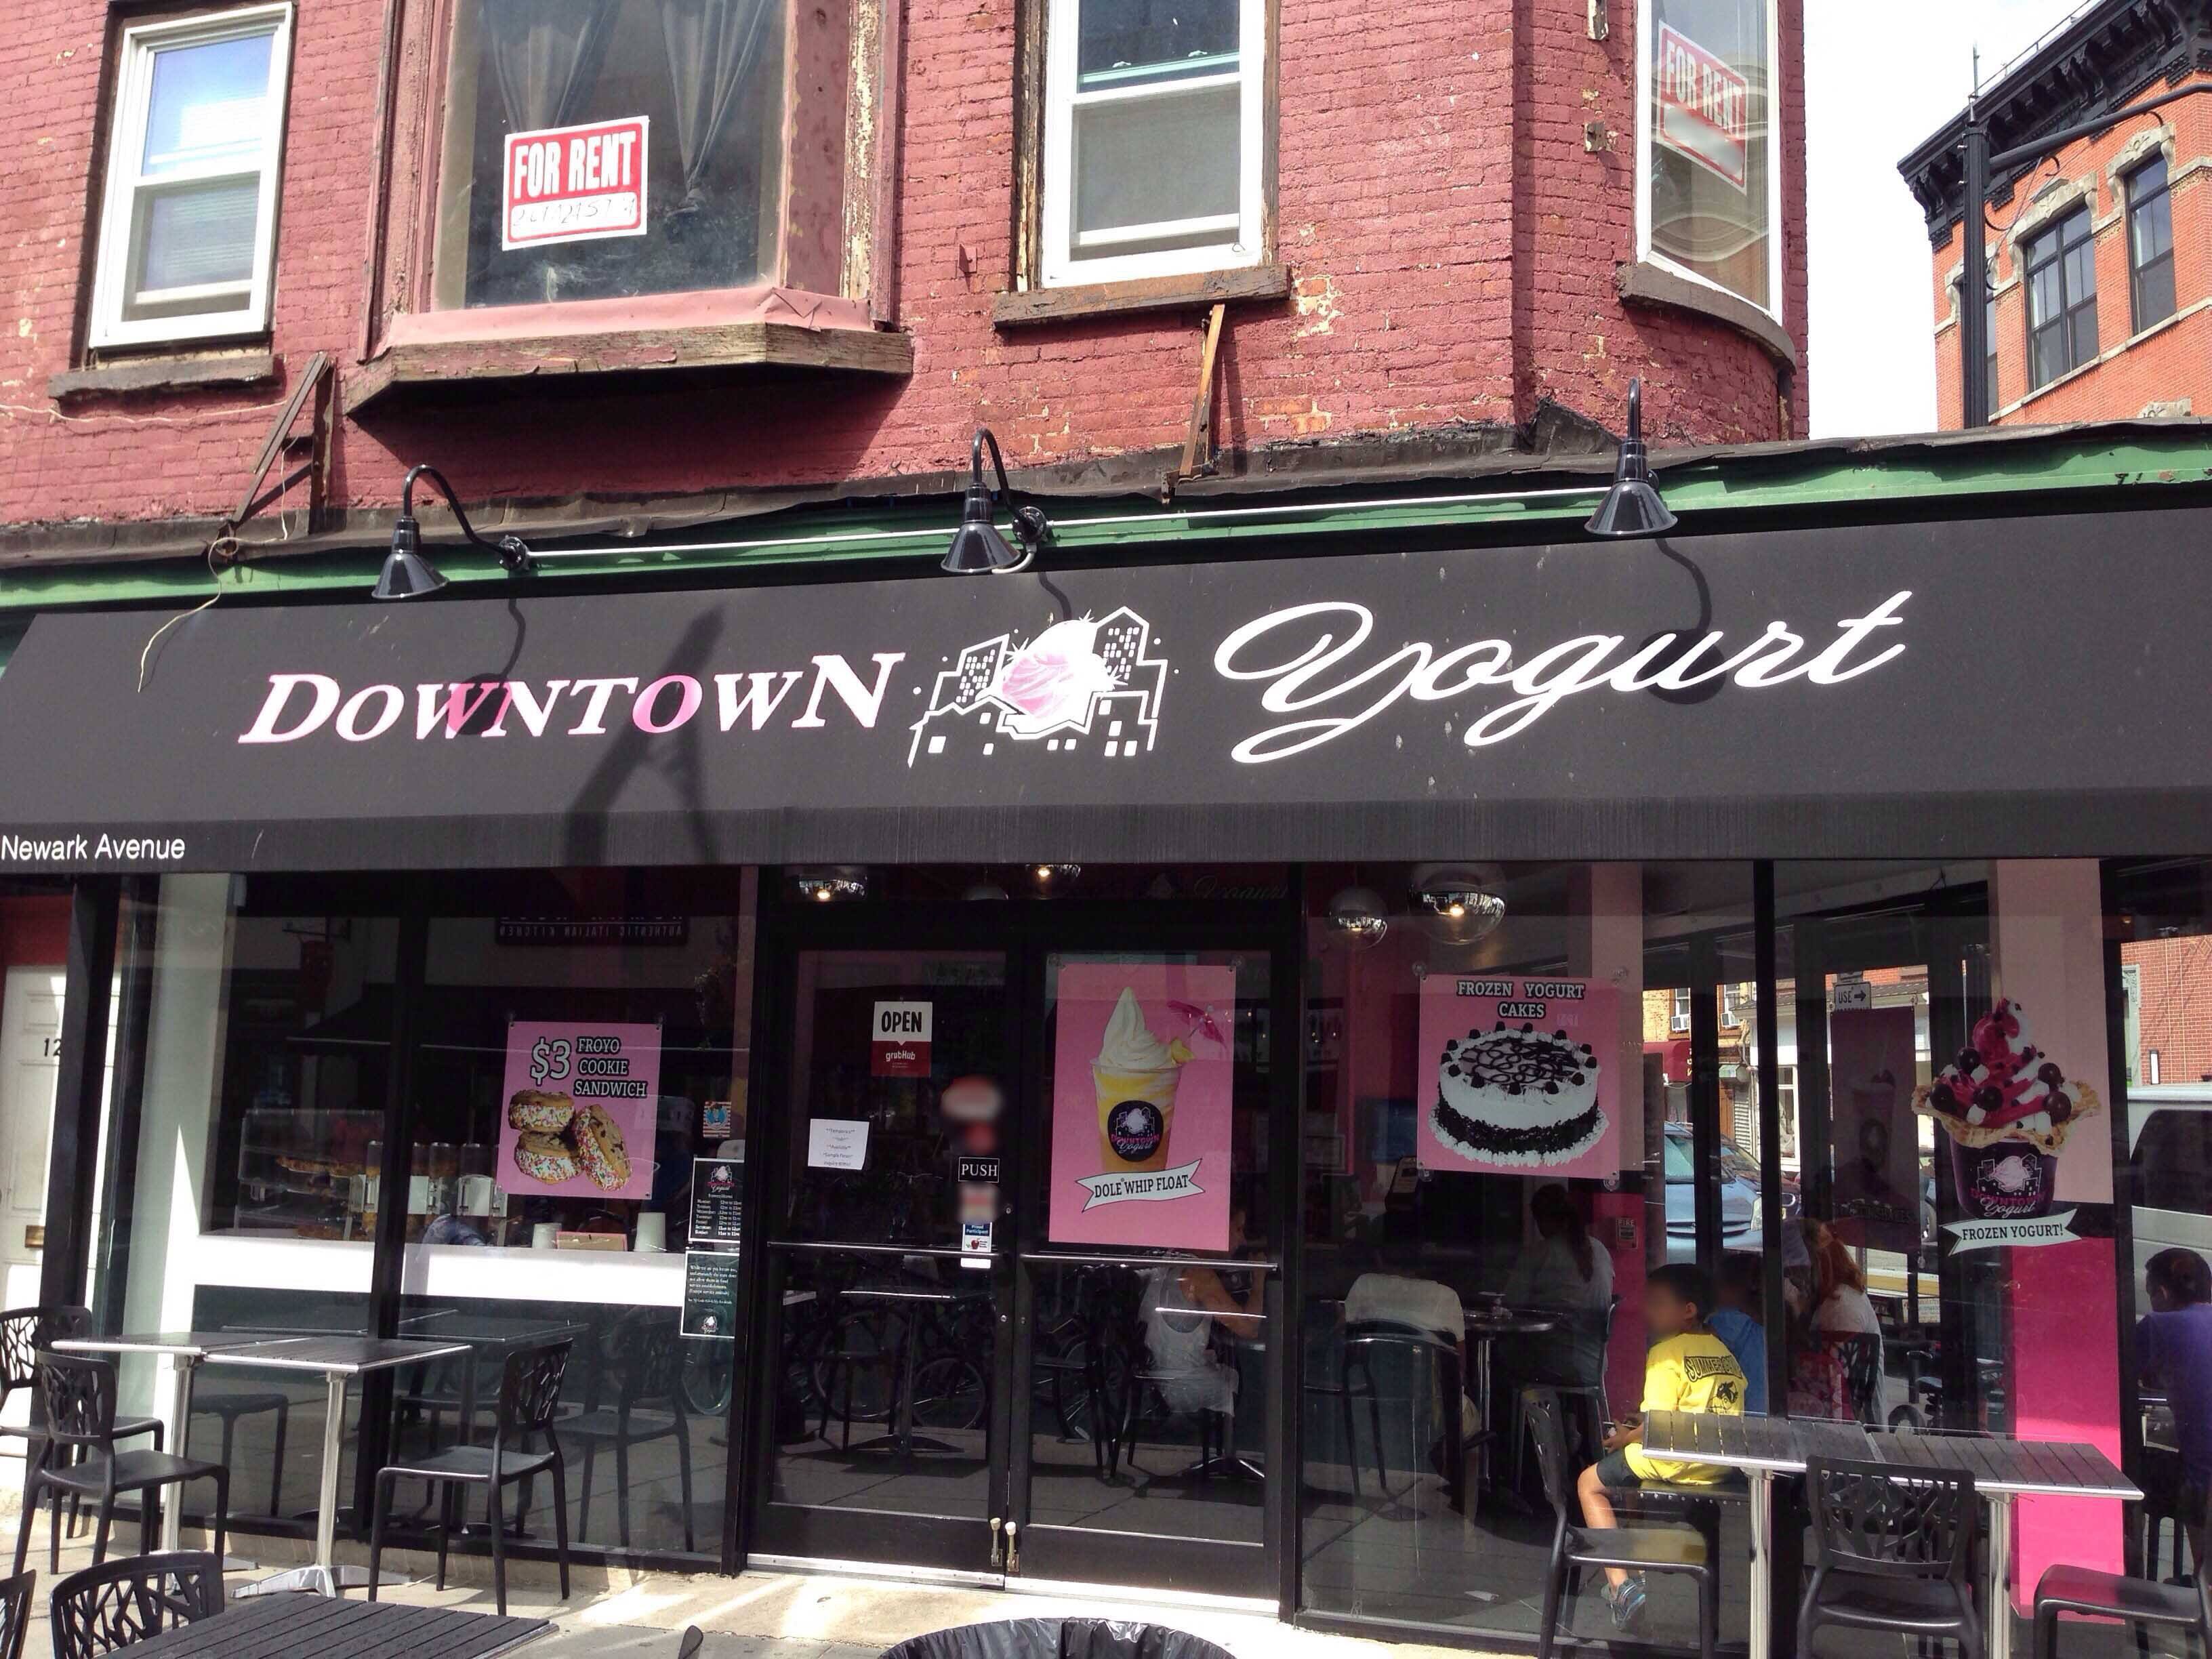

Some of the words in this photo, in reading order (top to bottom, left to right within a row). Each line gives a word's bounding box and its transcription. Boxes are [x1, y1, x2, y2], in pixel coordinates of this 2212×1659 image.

[1666, 39, 1697, 110] FOR
[1702, 62, 1742, 138] RENT
[513, 141, 562, 199] FOR
[567, 130, 636, 192] RENT
[238, 652, 905, 744] DOWNTOWN
[1214, 590, 1912, 764] Yogurt
[1, 833, 88, 860] Newark
[94, 833, 186, 859] Avenue
[1458, 981, 1513, 996] FROZEN
[1524, 983, 1584, 998] YOGURT
[1838, 991, 1852, 1003] USE
[1498, 1003, 1545, 1018] CAKES
[881, 1010, 922, 1032] OPEN
[578, 1038, 620, 1053] FROYO
[531, 1037, 571, 1086] $3
[579, 1059, 628, 1075] COOKIE
[575, 1081, 647, 1097] SANDWICH
[1116, 1139, 1153, 1154] Yogurt
[961, 1164, 998, 1176] PUSH
[1124, 1178, 1154, 1195] WHIP
[1156, 1174, 1189, 1191] FLOAT
[1980, 1197, 2036, 1218] Yogurt
[1962, 1227, 2008, 1241] FROZEN
[2012, 1223, 2064, 1238] YOGURT!
[1685, 1357, 1721, 1382] SUMMER
